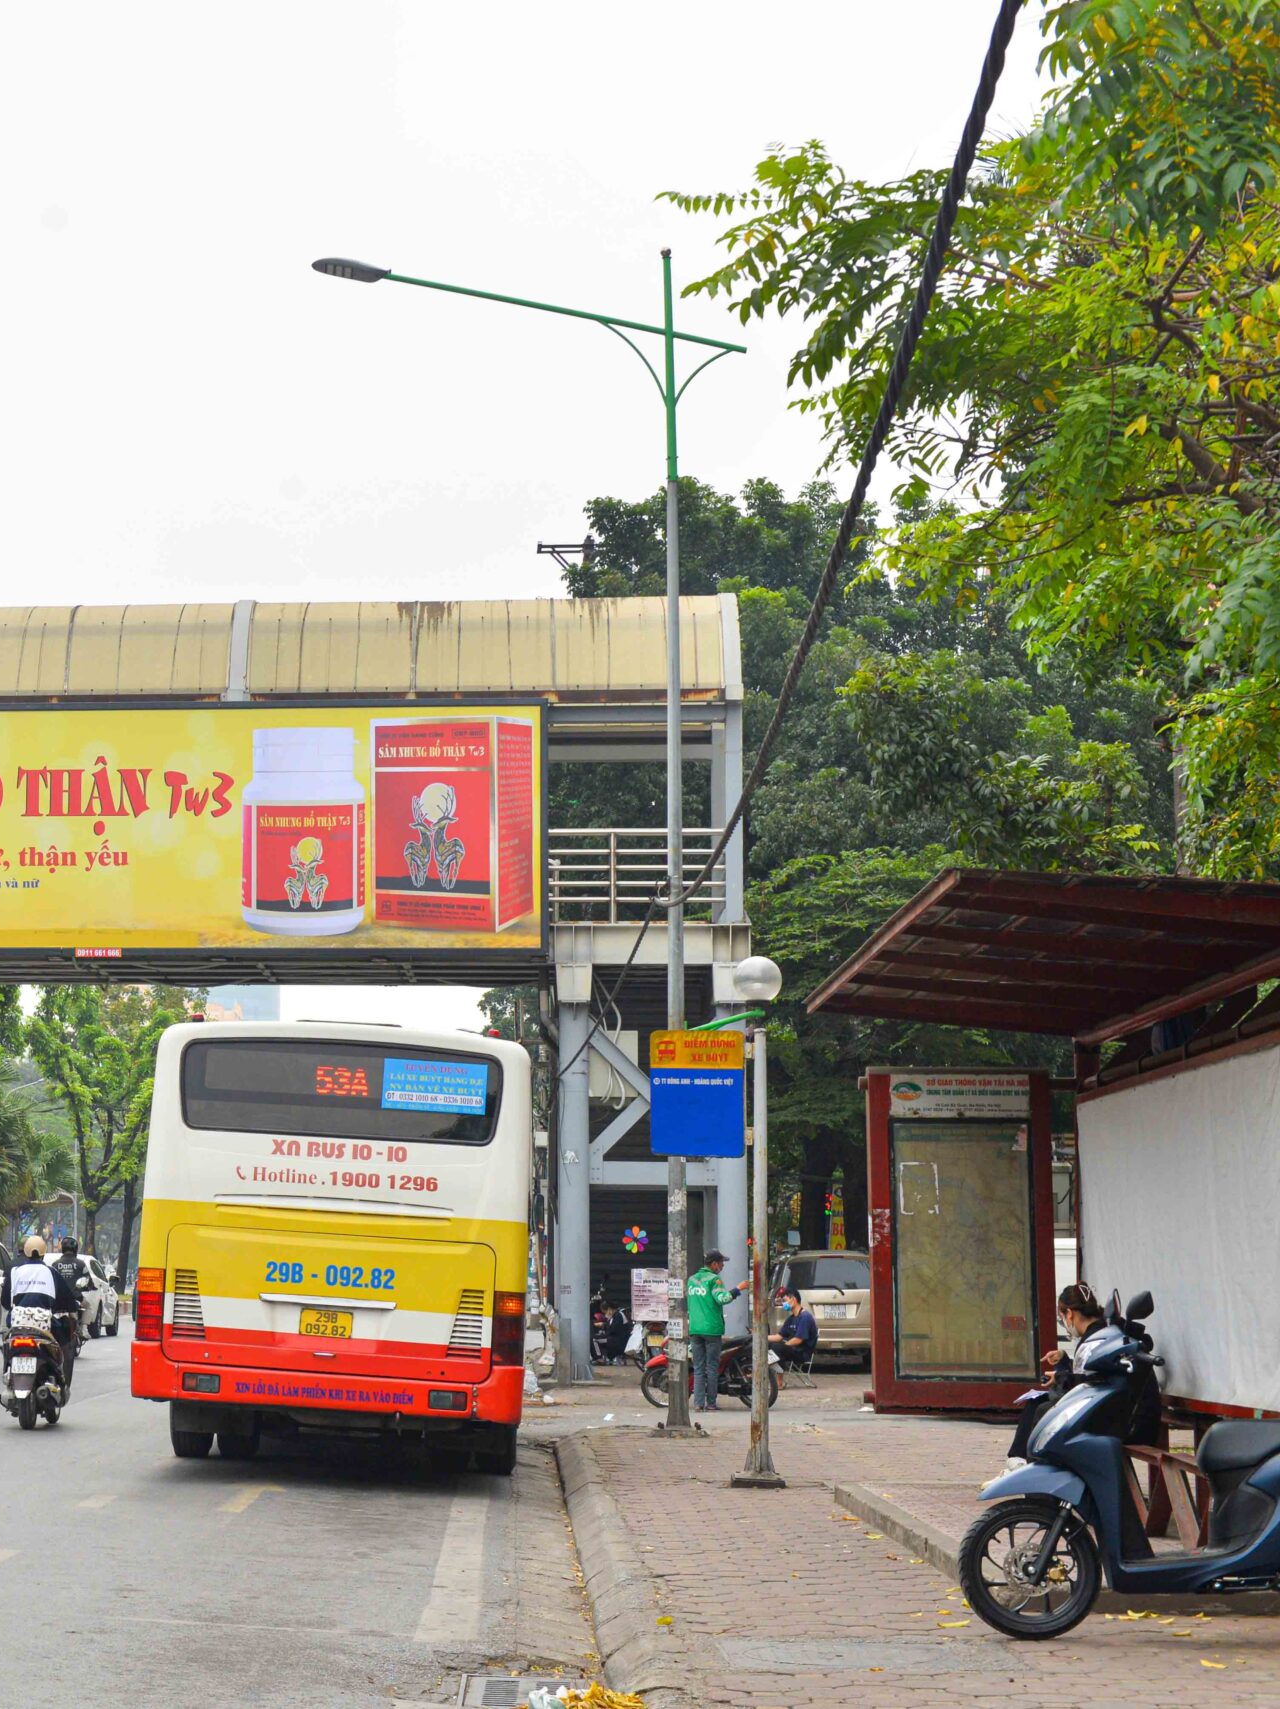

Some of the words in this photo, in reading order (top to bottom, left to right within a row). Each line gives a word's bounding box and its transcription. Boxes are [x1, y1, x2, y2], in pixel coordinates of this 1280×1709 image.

[378, 743, 397, 758] SÂM
[398, 746, 427, 758] NHUNG
[429, 739, 441, 758] BỔ
[443, 742, 466, 762] THẬN
[16, 756, 153, 836] THẬN
[260, 813, 273, 828] SÂM
[275, 816, 302, 828] NHUNG
[316, 812, 337, 832] THẬN
[18, 845, 77, 874] thận
[84, 839, 128, 872] yếu
[5, 877, 18, 889] và
[22, 878, 40, 889] nữ
[77, 949, 93, 957] 0911
[692, 1053, 704, 1062] XE
[316, 1066, 368, 1096] 53A
[937, 1079, 953, 1087] GIAO
[955, 1078, 977, 1087] THÔNG
[307, 1141, 346, 1160] BUS
[329, 1171, 380, 1189] 1900
[387, 1175, 439, 1192] 1296
[265, 1261, 303, 1284] 29B
[325, 1265, 396, 1290] 092.82
[315, 1311, 338, 1324] 29B
[305, 1323, 347, 1337] 092.82
[235, 1382, 250, 1393] XIN
[328, 1388, 344, 1401] KHI
[346, 1389, 357, 1402] XE
[359, 1390, 371, 1402] RA
